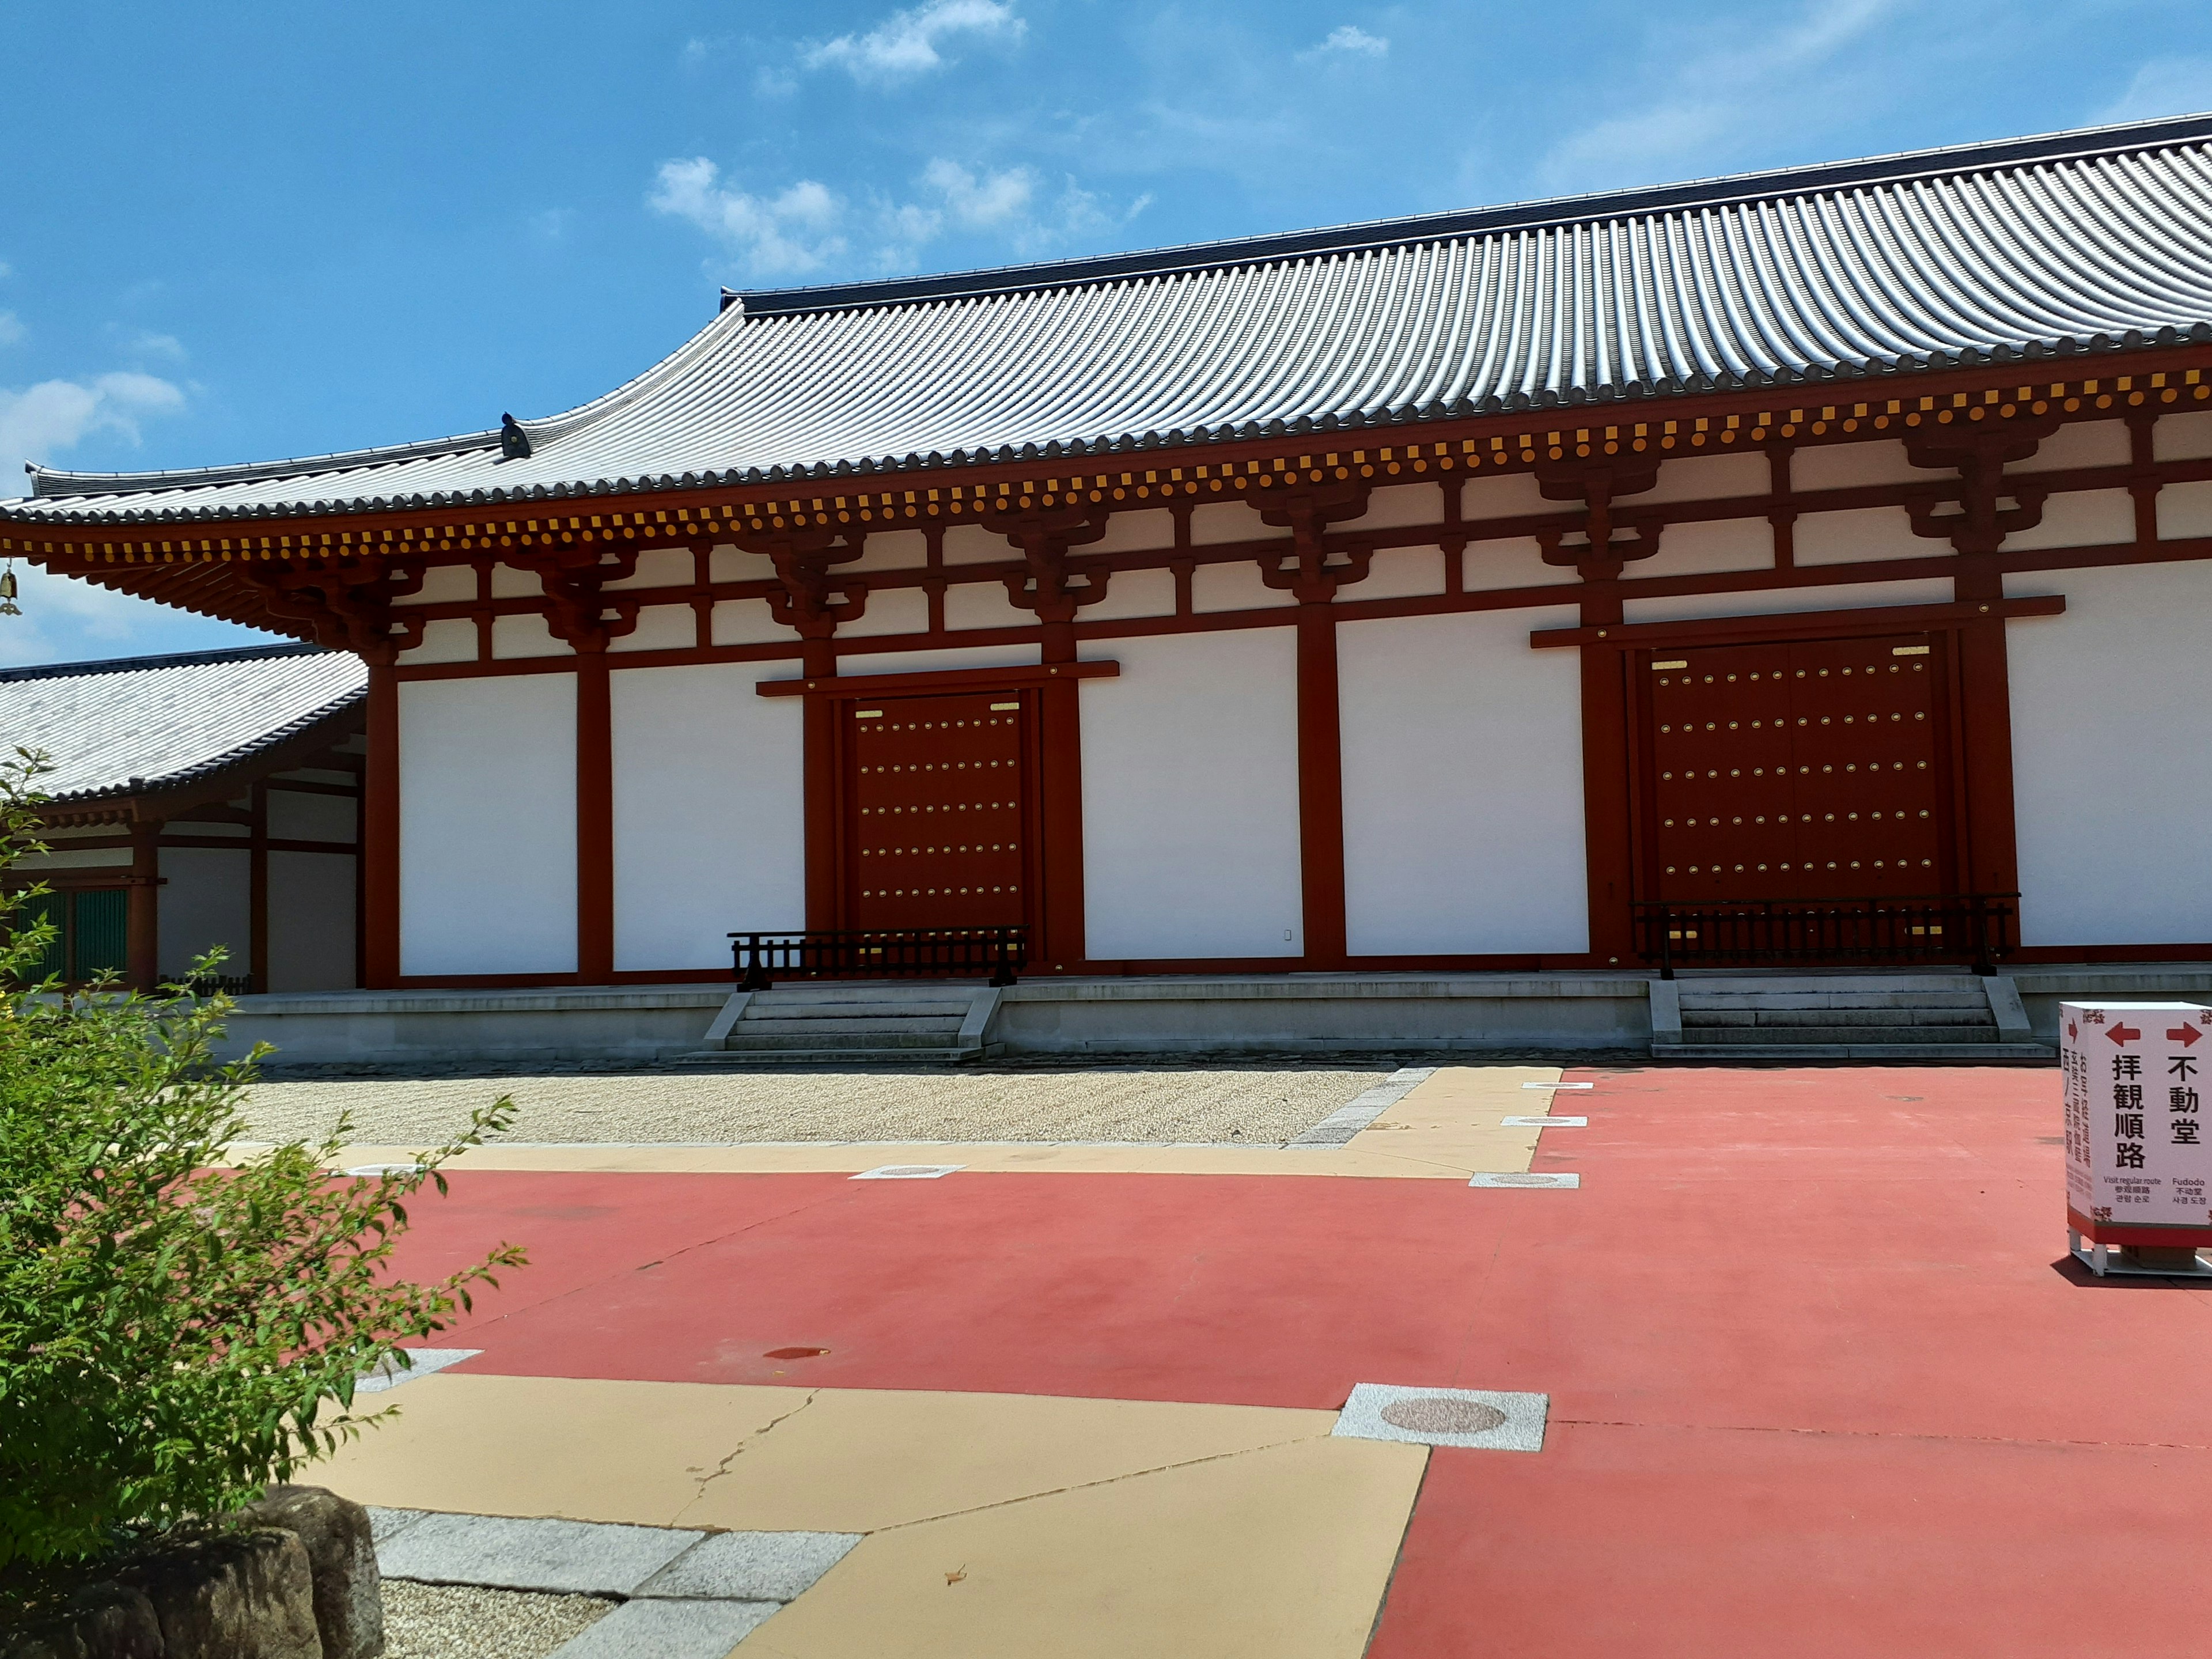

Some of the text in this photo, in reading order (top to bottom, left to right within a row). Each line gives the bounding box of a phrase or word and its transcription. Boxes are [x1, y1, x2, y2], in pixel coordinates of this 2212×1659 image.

[2168, 1056, 2200, 1145] 不動堂
[2080, 1052, 2091, 1168] お写経道場
[2112, 1054, 2146, 1169] 拝観順路
[2120, 1177, 2142, 1185] regular
[2172, 1177, 2205, 1185] Fudodo
[2176, 1187, 2202, 1195] 不动堂
[2172, 1196, 2188, 1205] 사경
